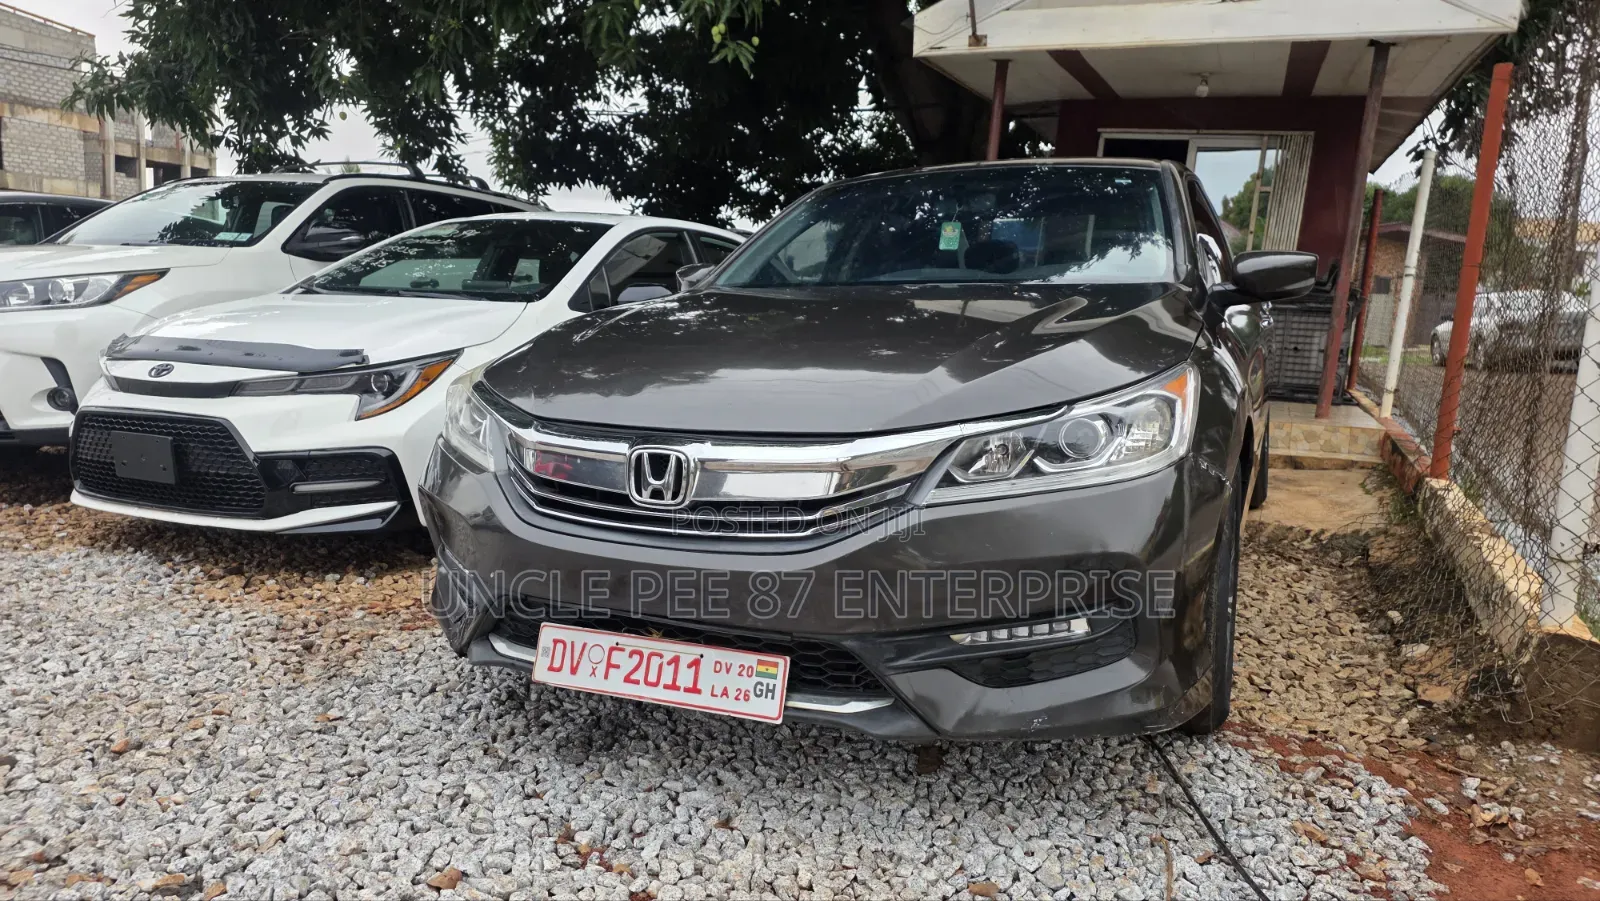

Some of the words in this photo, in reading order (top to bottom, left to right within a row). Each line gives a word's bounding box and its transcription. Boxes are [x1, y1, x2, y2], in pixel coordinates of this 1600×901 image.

[547, 638, 588, 676] DV
[604, 646, 703, 695] F2011
[713, 660, 733, 675] DV
[737, 663, 754, 678] 20
[710, 684, 730, 699] LA
[735, 688, 751, 702] 26
[753, 681, 777, 700] GH
